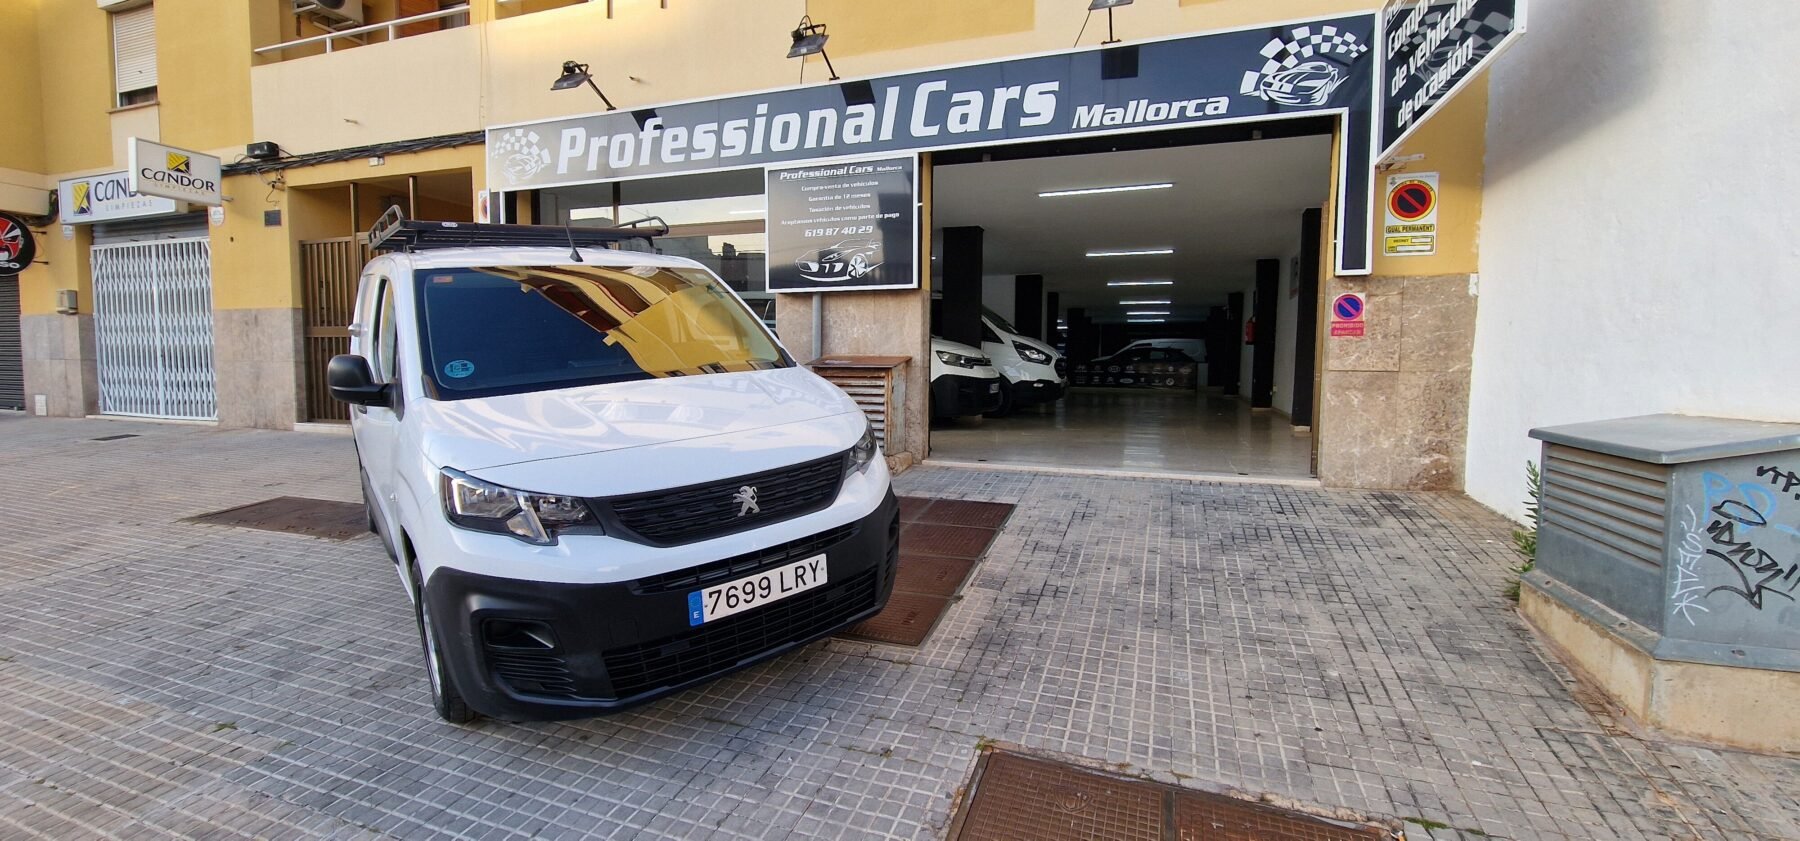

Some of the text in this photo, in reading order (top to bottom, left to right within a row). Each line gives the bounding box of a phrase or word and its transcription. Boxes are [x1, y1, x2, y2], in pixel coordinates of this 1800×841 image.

[1391, 64, 1407, 97] de
[1397, 36, 1474, 128] de ocasión
[557, 79, 1230, 175] Professional Cars Mallorca
[780, 166, 847, 180] Professional
[848, 165, 874, 174] Cars
[884, 212, 900, 220] pago
[804, 225, 873, 237] 619 87 40 29
[708, 560, 820, 615] 7699 LRY
[693, 611, 700, 619] E
